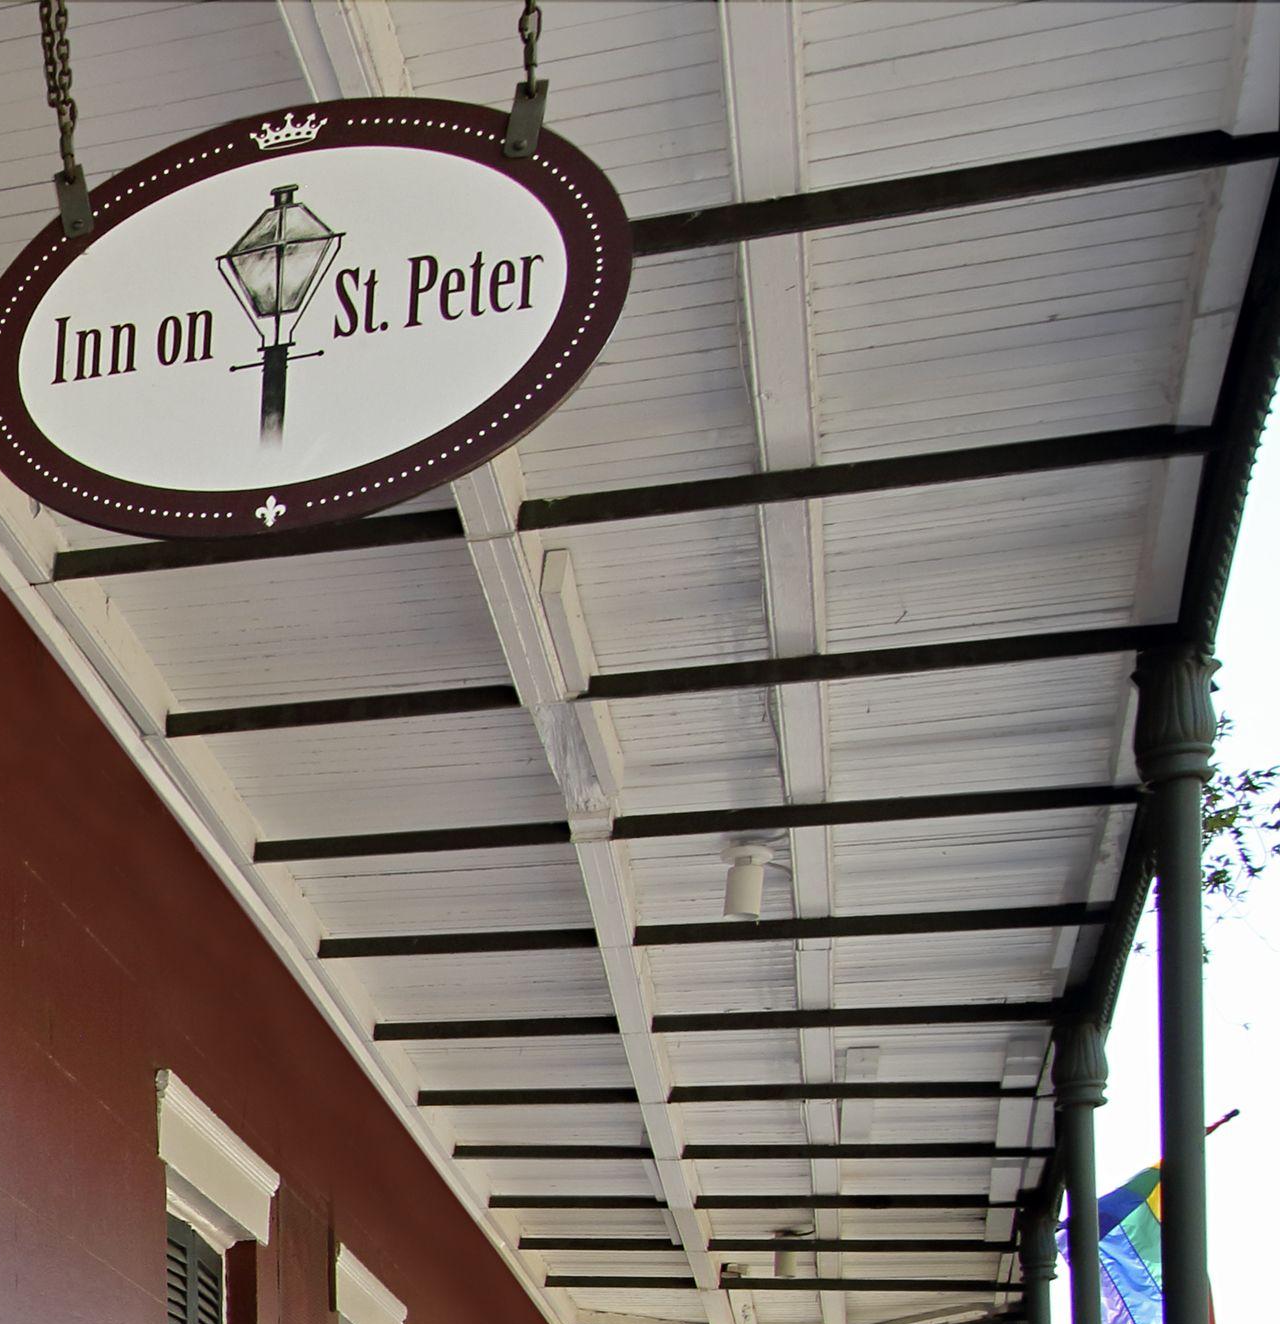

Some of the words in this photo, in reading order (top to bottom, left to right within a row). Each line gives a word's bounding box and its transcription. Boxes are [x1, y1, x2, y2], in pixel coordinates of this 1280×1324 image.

[51, 314, 137, 385] Inn
[156, 306, 215, 365] on
[333, 267, 390, 339] St.
[404, 250, 545, 329] Peter
